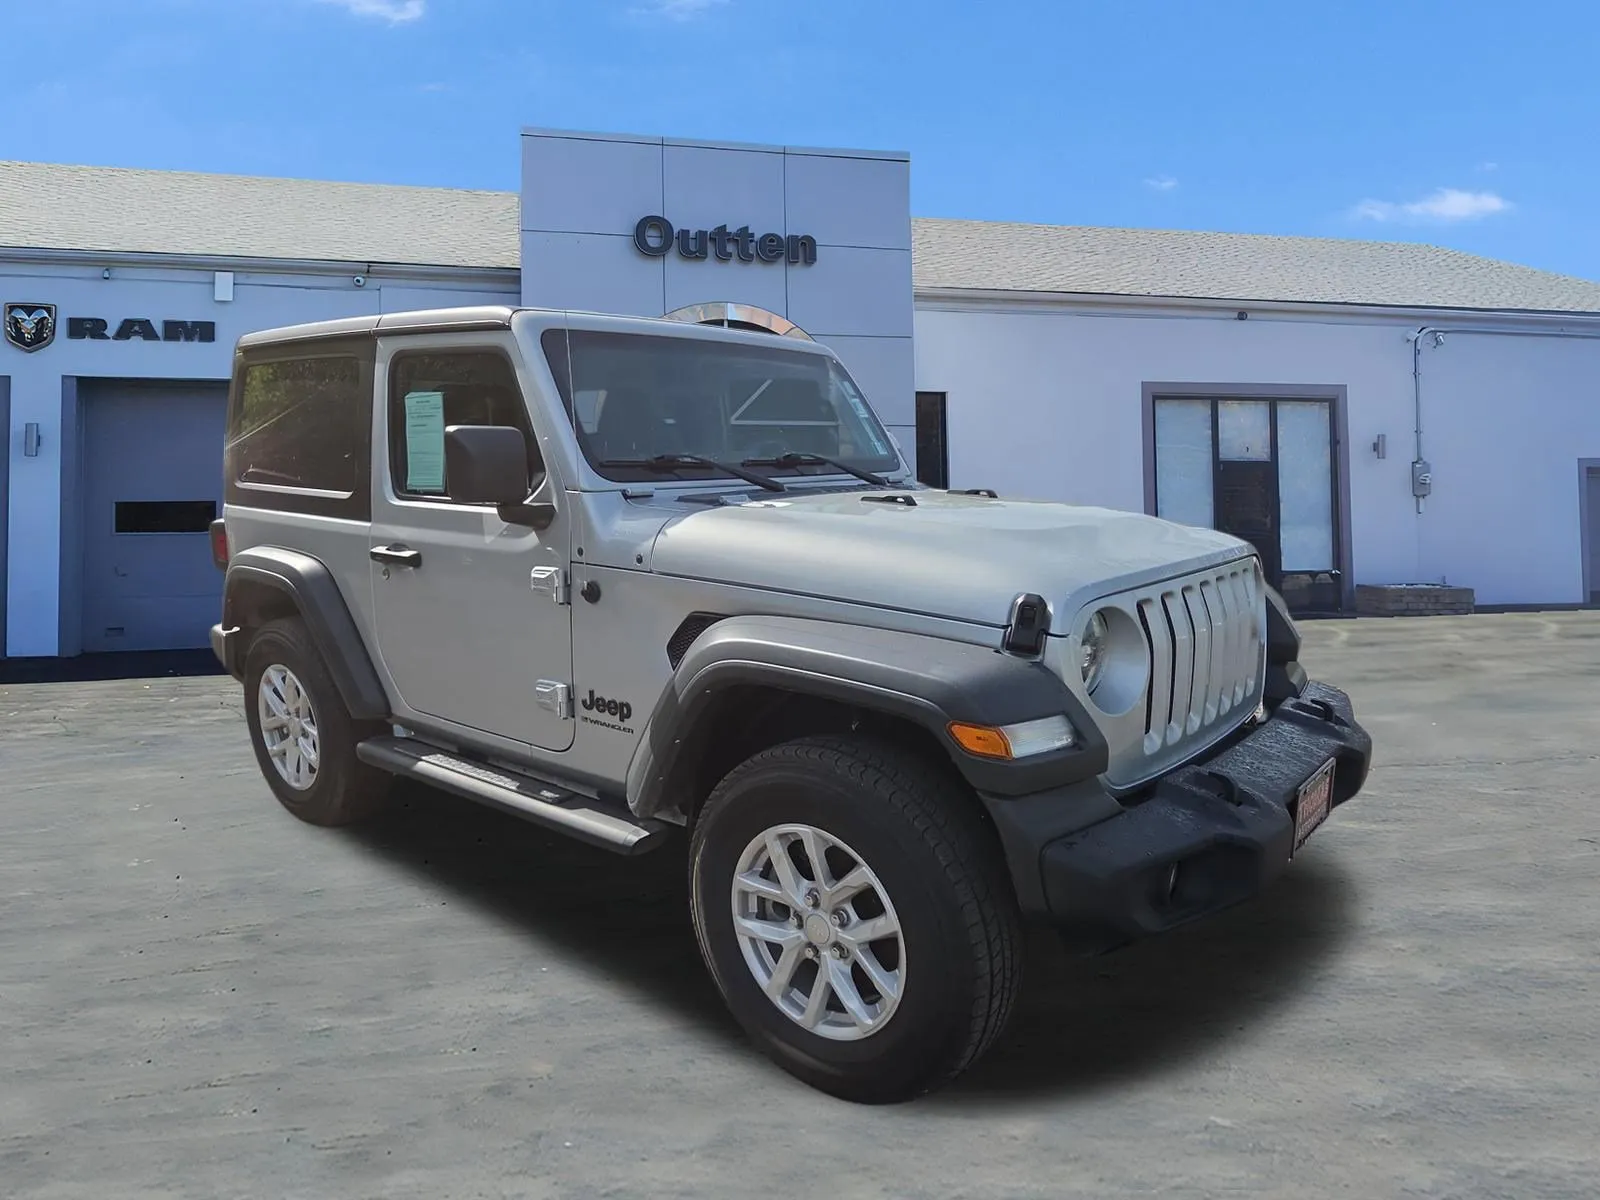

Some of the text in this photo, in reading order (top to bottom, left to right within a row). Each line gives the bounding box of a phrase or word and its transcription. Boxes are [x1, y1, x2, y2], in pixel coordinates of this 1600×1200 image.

[634, 215, 817, 264] Outten
[66, 317, 216, 342] RAM
[581, 689, 632, 722] Jeep
